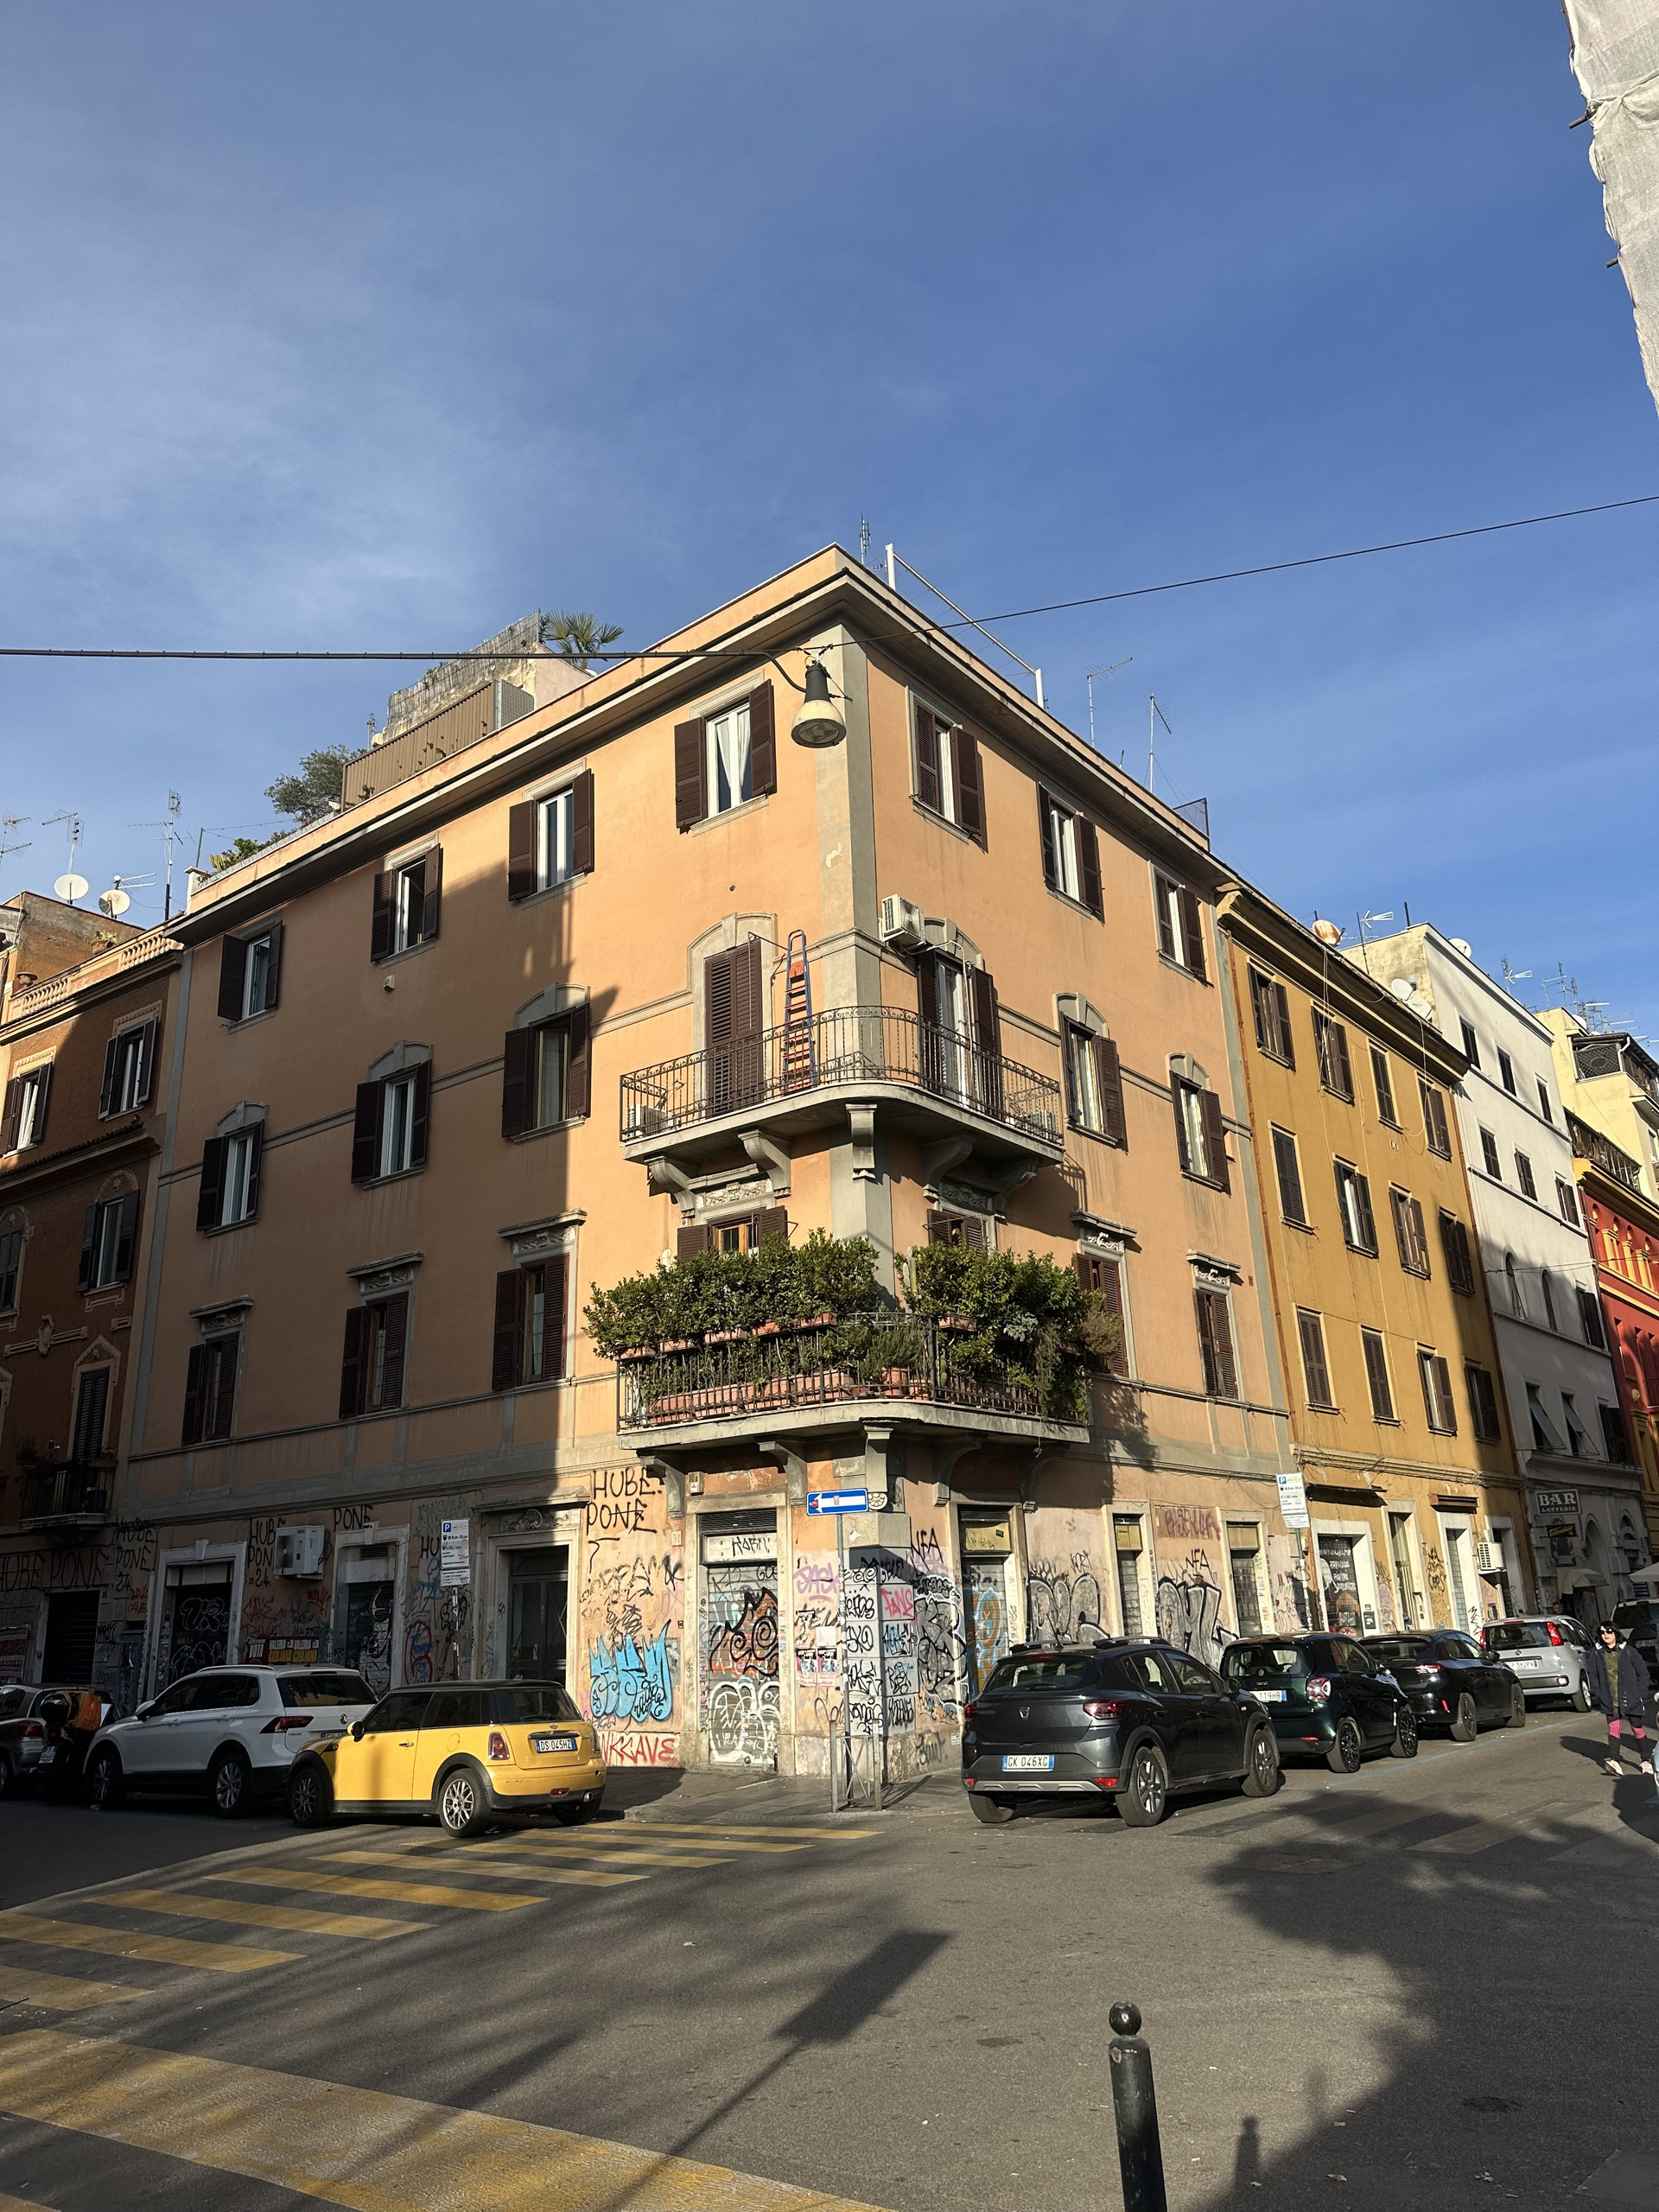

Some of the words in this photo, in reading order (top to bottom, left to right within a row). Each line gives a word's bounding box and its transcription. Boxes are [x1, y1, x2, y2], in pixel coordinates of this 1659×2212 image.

[1538, 1492, 1577, 1507] BAR
[587, 1498, 657, 1535] PONE
[673, 1535, 681, 1543] 31
[116, 1546, 153, 1572] PONE
[249, 1643, 264, 1658] VOTA
[540, 1741, 550, 1751] DS
[551, 1739, 571, 1750] 045HZ
[1008, 1757, 1019, 1767] GK
[1021, 1757, 1048, 1767] 046XG
